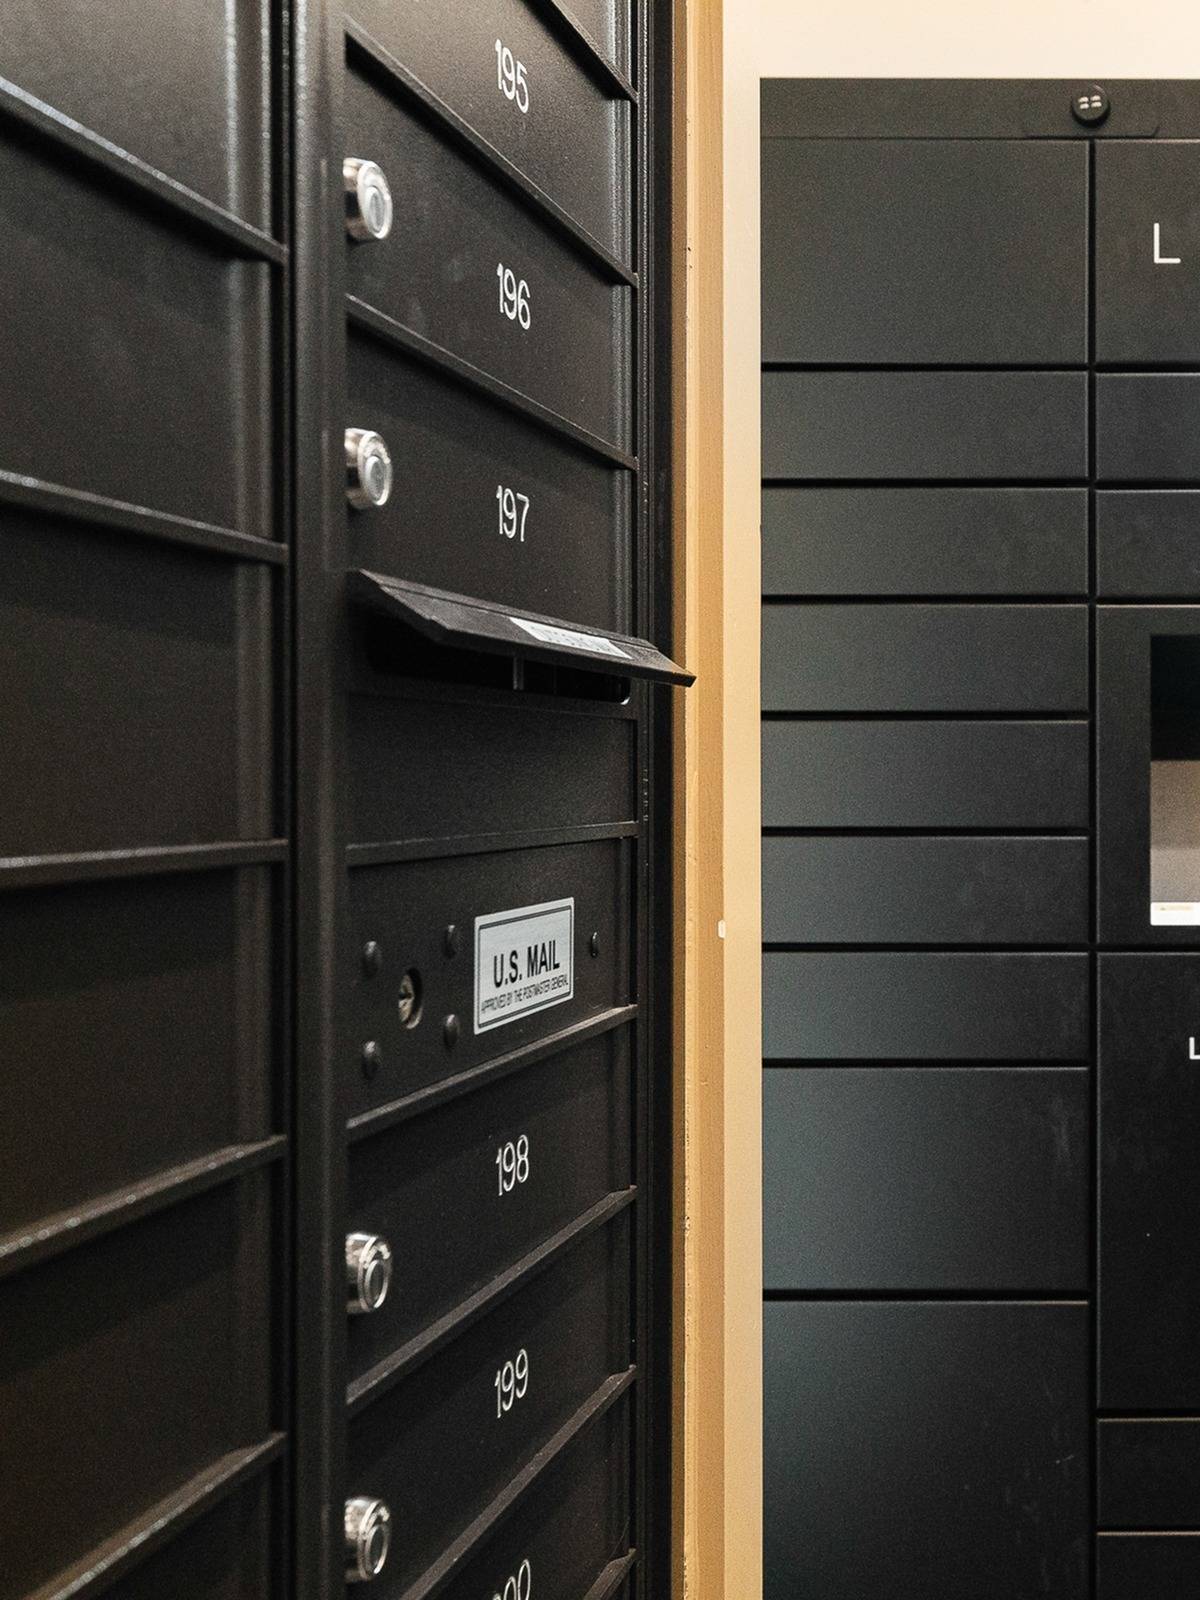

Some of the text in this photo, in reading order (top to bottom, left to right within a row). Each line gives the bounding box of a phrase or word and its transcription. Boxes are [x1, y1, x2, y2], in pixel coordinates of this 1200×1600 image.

[494, 38, 529, 114] 195
[496, 263, 531, 330] 196
[495, 485, 530, 542] 197
[493, 939, 560, 988] U.S. MAIL
[495, 1134, 530, 1196] 198
[494, 1348, 529, 1419] 199
